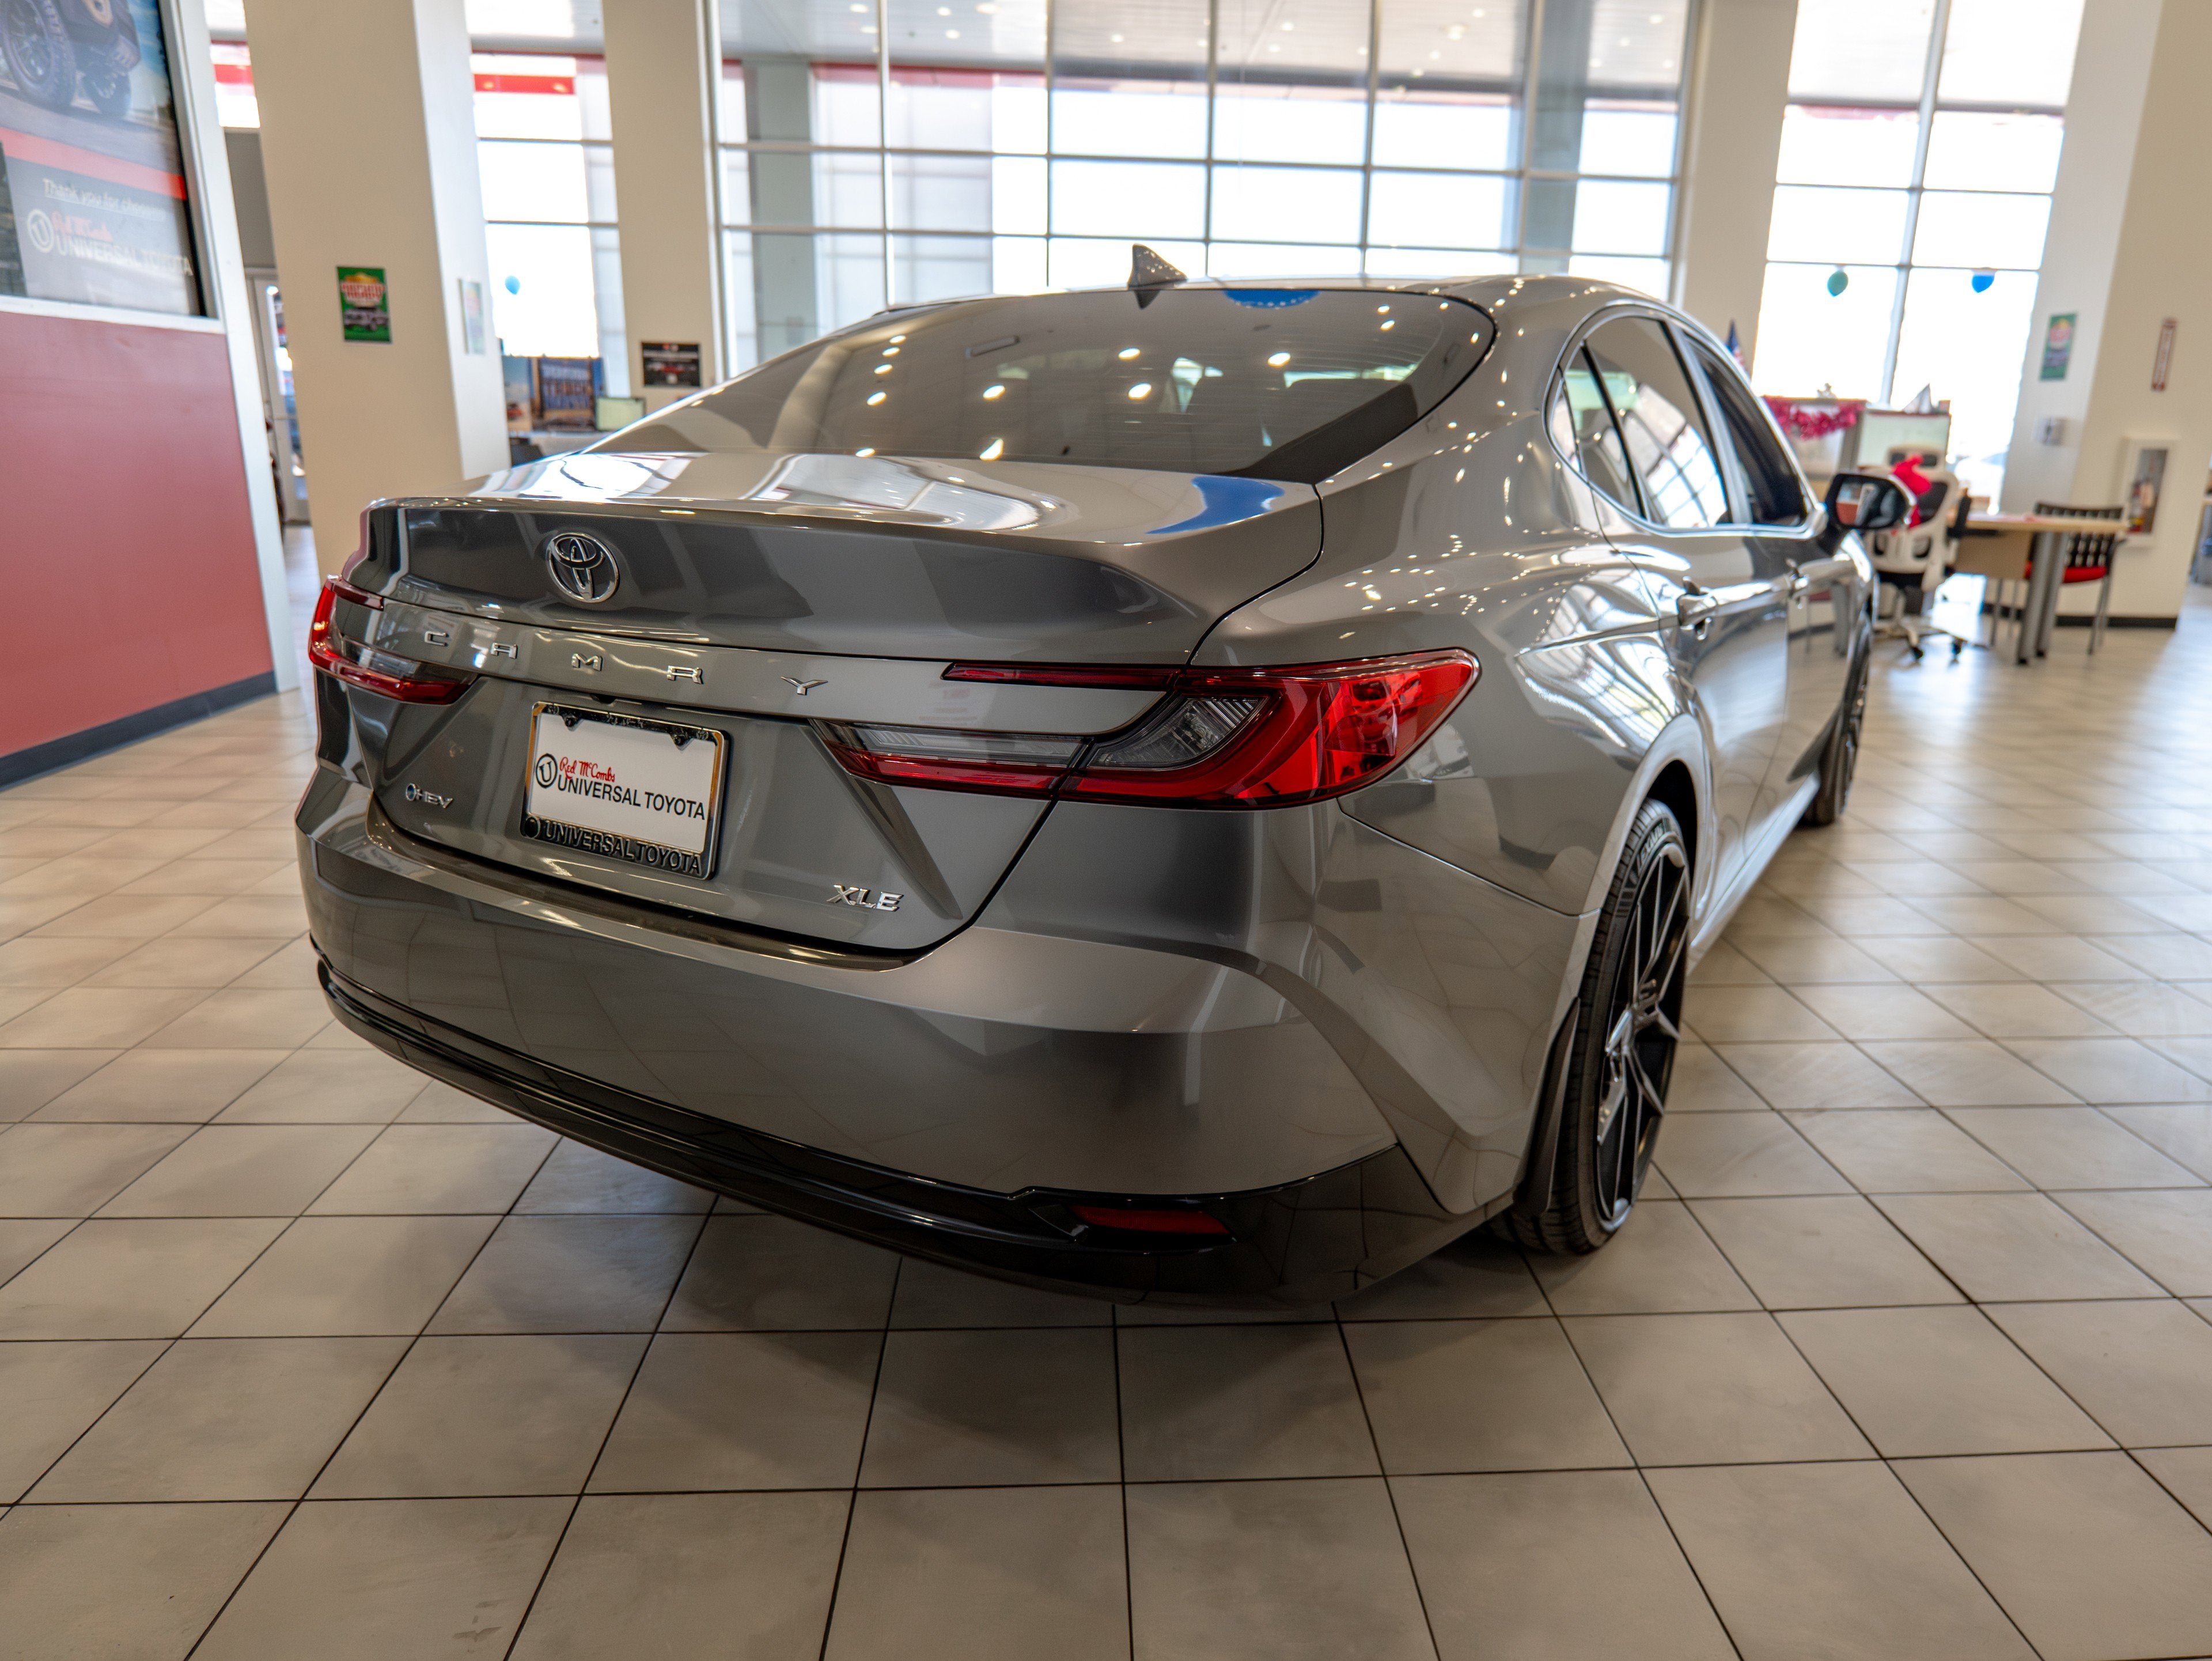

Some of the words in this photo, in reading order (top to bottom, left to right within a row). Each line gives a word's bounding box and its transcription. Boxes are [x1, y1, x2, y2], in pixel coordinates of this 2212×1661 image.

[43, 177, 79, 200] Thank
[55, 233, 141, 268] UNIVERSAL
[424, 630, 829, 695] CAMRY
[559, 756, 577, 780] Red
[578, 760, 615, 782] McCombs
[558, 774, 641, 807] UNIVERSAL
[644, 791, 705, 820] TOYOTA
[545, 820, 634, 860] UNIVERSAL
[635, 841, 702, 877] TOYOTA
[826, 884, 904, 911] XLE
